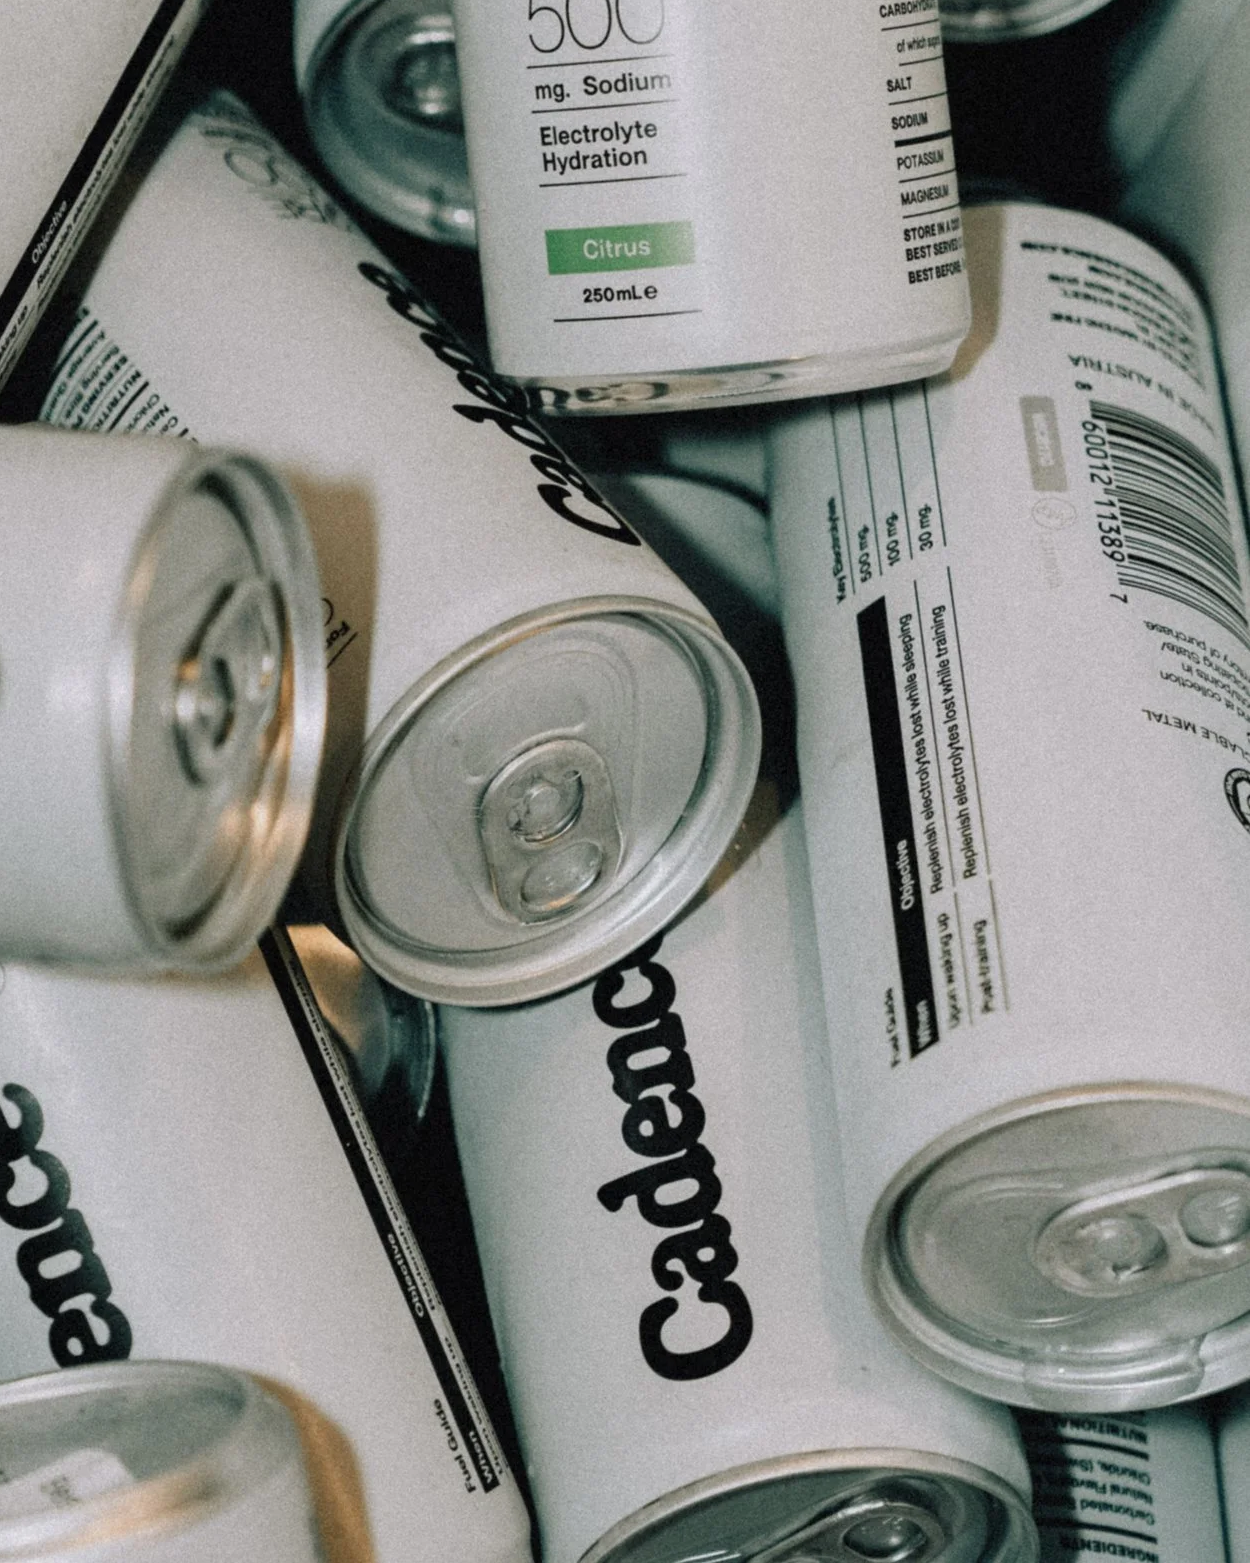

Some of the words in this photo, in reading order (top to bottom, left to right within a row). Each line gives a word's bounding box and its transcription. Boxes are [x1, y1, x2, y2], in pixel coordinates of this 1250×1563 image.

[535, 81, 571, 104] mg.
[582, 70, 672, 96] Sodium
[886, 76, 912, 93] SALT
[539, 120, 658, 147] Electrolyte
[891, 111, 928, 130] SODIUM
[542, 148, 648, 175] Hydration
[896, 148, 944, 170] POTASSIUM
[900, 184, 949, 206] MAGNESIUM
[31, 200, 68, 264] Objective
[582, 238, 651, 260] Citrus
[903, 223, 936, 242] STORE
[906, 244, 931, 262] BEST
[908, 267, 934, 284] BEST
[81, 355, 128, 414] SERVING
[1068, 353, 1152, 388] AUSTRIA
[1075, 380, 1093, 393] 8
[886, 540, 900, 567] 100
[918, 531, 934, 551] 30
[858, 552, 872, 583] 500
[1110, 592, 1129, 605] 7
[898, 613, 916, 669] sleeping
[932, 605, 948, 659] training
[905, 672, 921, 709] while
[937, 659, 953, 695] while
[1160, 669, 1222, 703] collection
[910, 710, 924, 740] lost
[942, 695, 957, 725] lost
[1142, 708, 1197, 734] METAL
[914, 738, 935, 822] electrolytes
[948, 725, 968, 805] electrolytes
[923, 822, 943, 895] Replenish
[956, 807, 978, 880] Replenish
[896, 839, 915, 911] Objective
[937, 913, 950, 933] up
[939, 933, 955, 986] waking
[972, 919, 994, 1015] Post-training
[884, 987, 897, 1034] Guide
[915, 999, 933, 1049] When
[947, 988, 962, 1031] Upon
[592, 933, 754, 1381] Cadenc
[388, 1233, 424, 1318] Objective
[434, 1399, 459, 1452] Guide
[454, 1454, 476, 1493] Fuel
[469, 1431, 493, 1484] When
[1080, 1498, 1155, 1526] Carbonated
